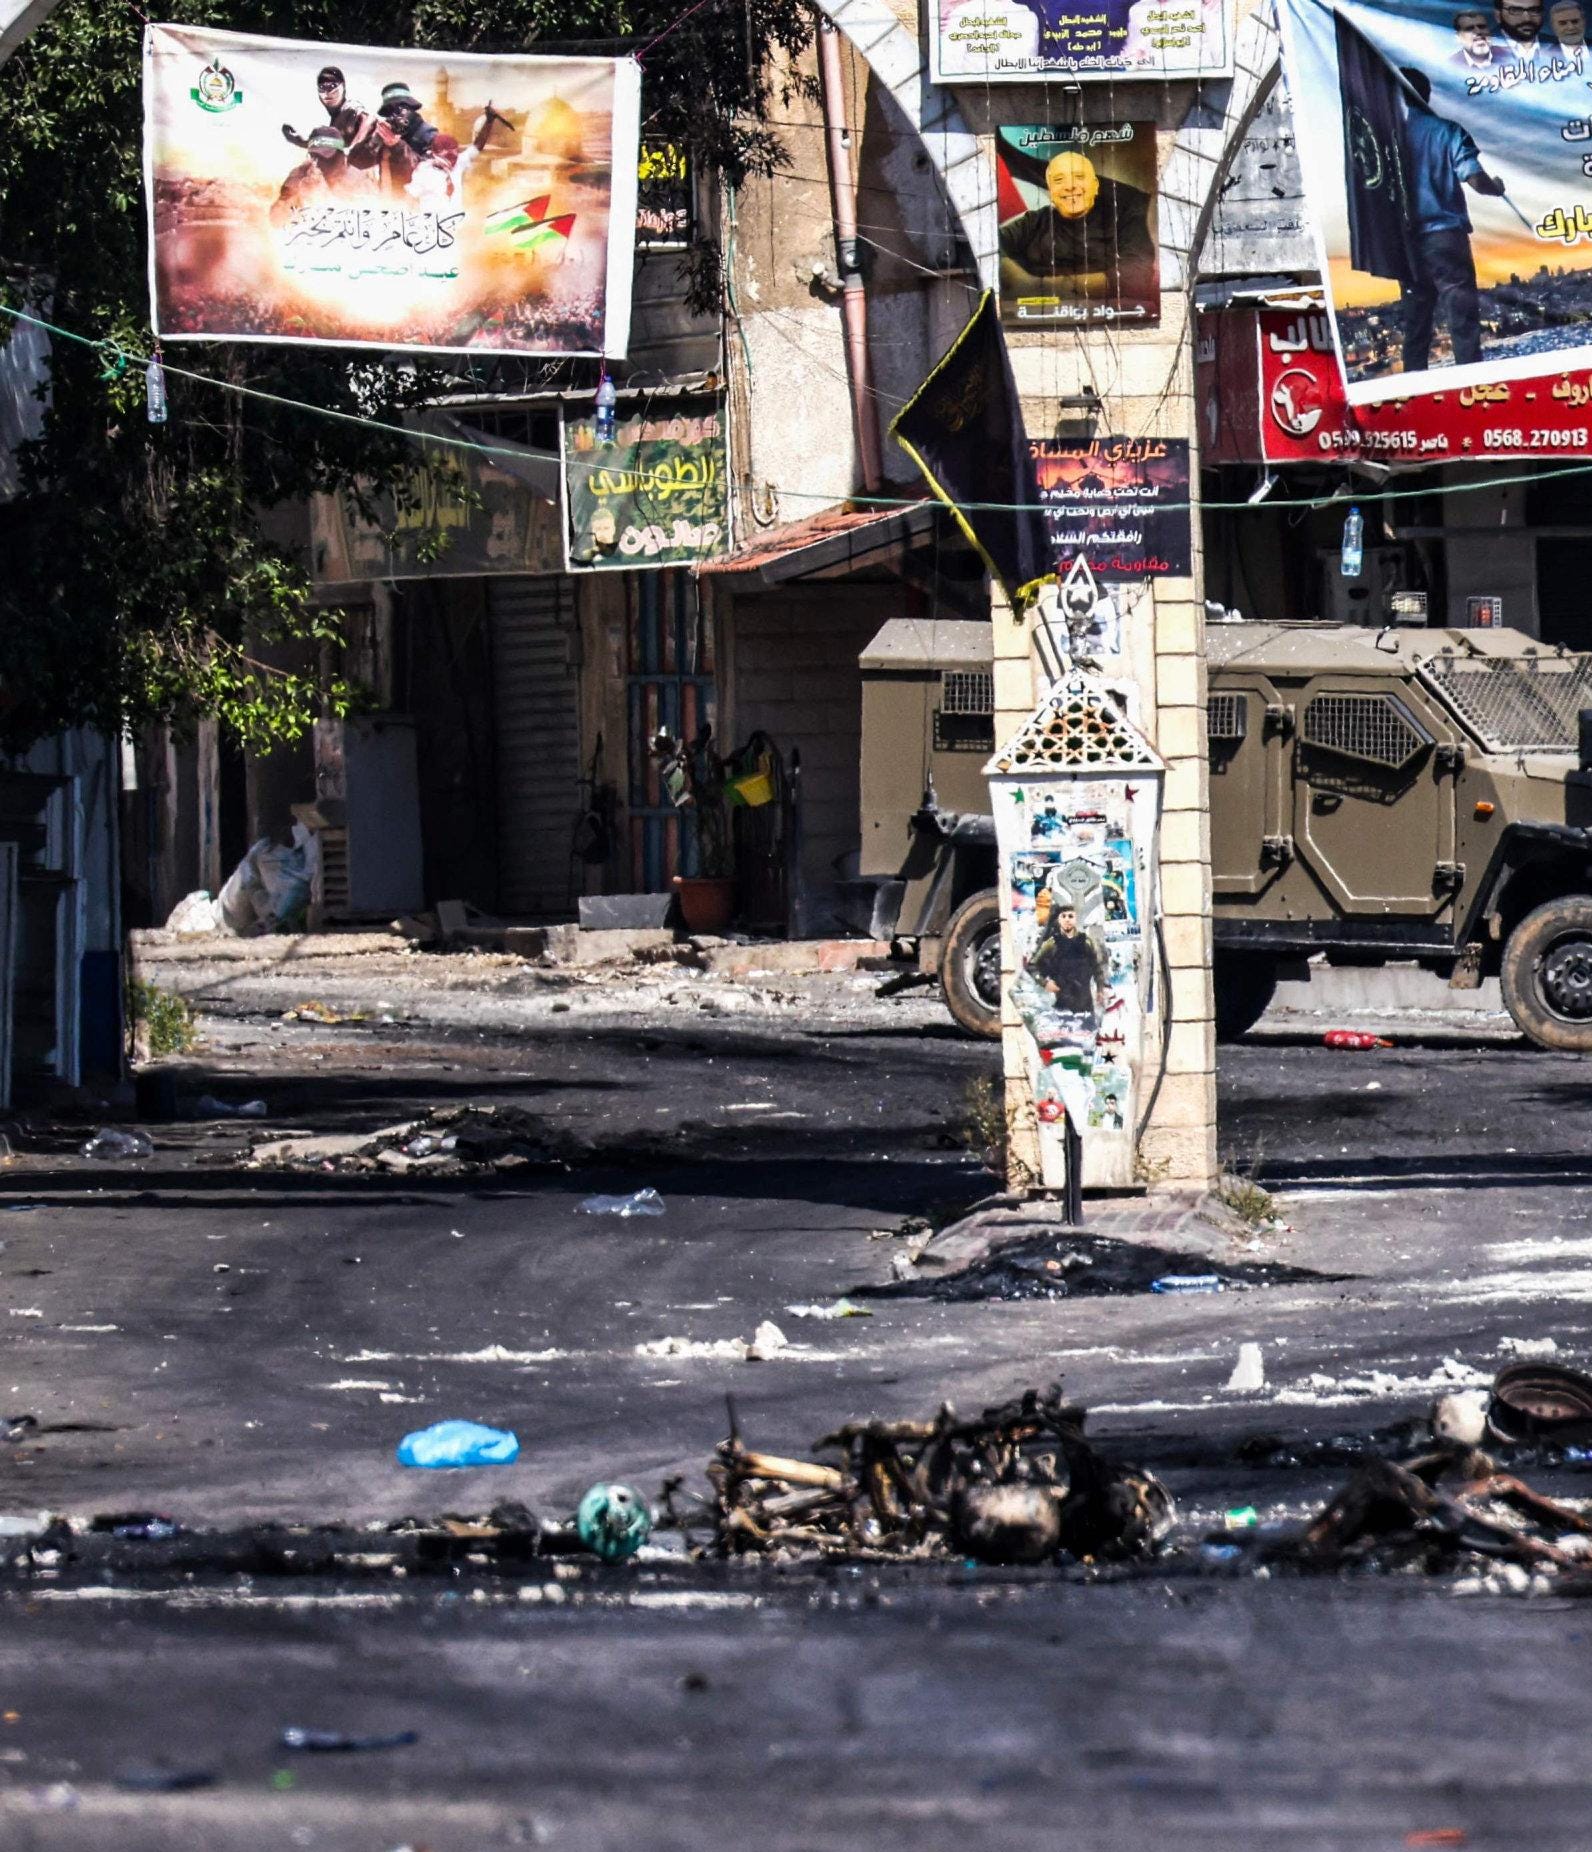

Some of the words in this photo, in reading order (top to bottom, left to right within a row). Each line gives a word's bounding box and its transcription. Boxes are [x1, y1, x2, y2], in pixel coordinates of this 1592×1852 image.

[1465, 57, 1535, 97] المقاومة
[1539, 46, 1583, 83] أمناء
[1019, 126, 1089, 148] فلسطين
[411, 209, 466, 254] كل
[1082, 486, 1112, 499] حماية
[1113, 486, 1139, 498] تحت
[619, 517, 722, 557] صالون
[1111, 553, 1170, 573] مقاومة
